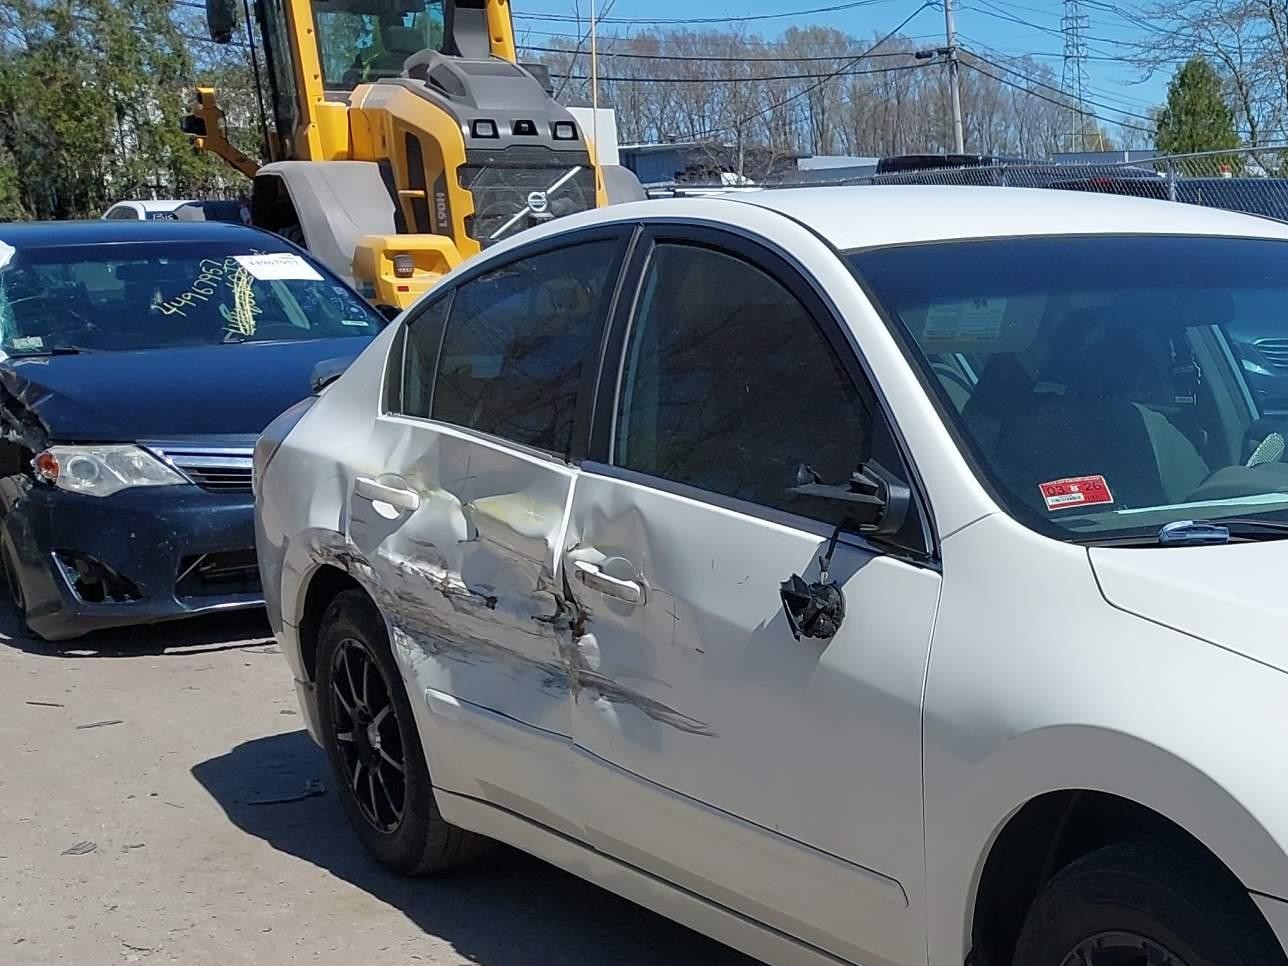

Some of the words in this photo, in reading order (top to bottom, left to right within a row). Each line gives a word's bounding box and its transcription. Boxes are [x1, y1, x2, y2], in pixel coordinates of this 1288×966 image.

[435, 192, 449, 228] L90H
[1046, 485, 1066, 497] 03
[1084, 481, 1102, 492] 26
